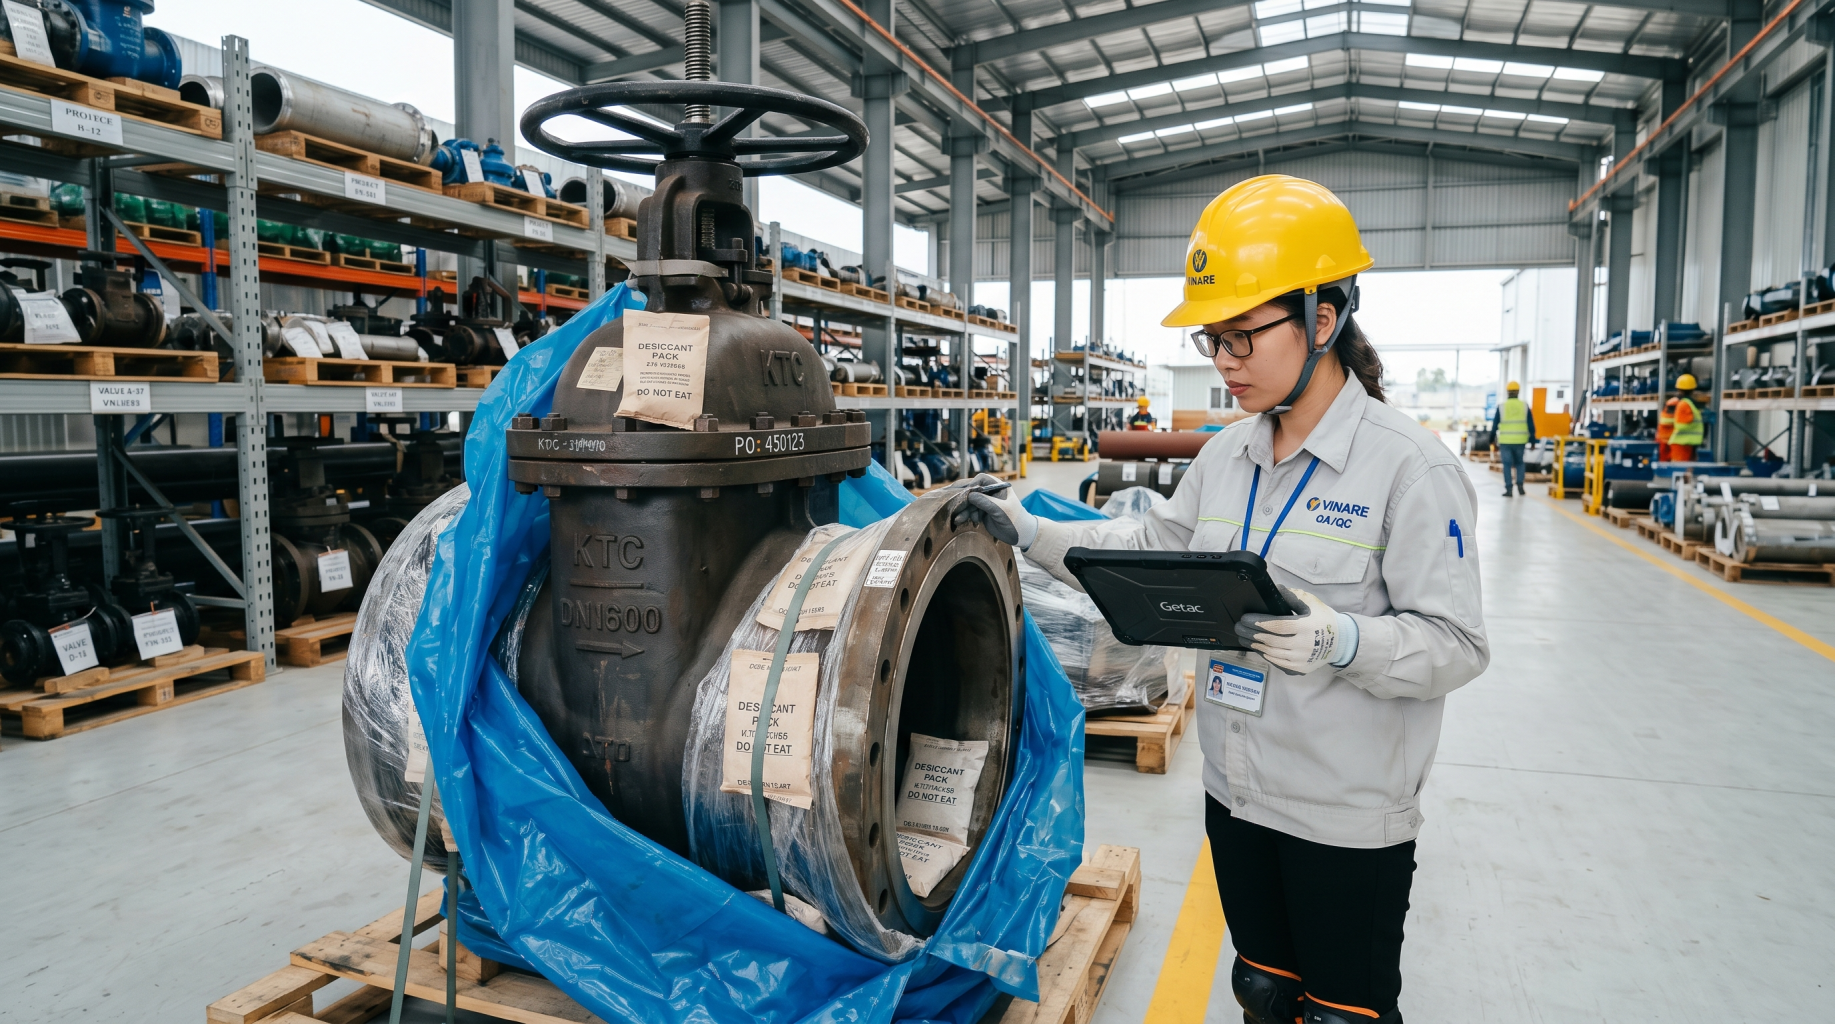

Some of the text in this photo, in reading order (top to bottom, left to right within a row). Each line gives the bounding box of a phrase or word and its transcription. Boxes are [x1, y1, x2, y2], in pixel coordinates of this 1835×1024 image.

[638, 343, 694, 352] DESICCANT
[652, 352, 679, 361] PACK
[760, 349, 805, 387] KTC
[637, 388, 693, 400] DO NOT EAT
[735, 433, 805, 455] PO: 450123
[1322, 499, 1370, 518] VINARE
[573, 533, 645, 570] KTC
[820, 580, 838, 588] EAT
[1159, 601, 1205, 613] Getac
[560, 598, 662, 634] DN1600
[62, 638, 88, 652] VALVE
[738, 701, 796, 714] DESCANT
[752, 716, 780, 728] PCK
[736, 741, 751, 751] DO
[773, 744, 793, 754] EAT
[914, 762, 965, 776] DESICCANT
[924, 773, 949, 784] PACK
[907, 790, 958, 805] DO NOT EAT
